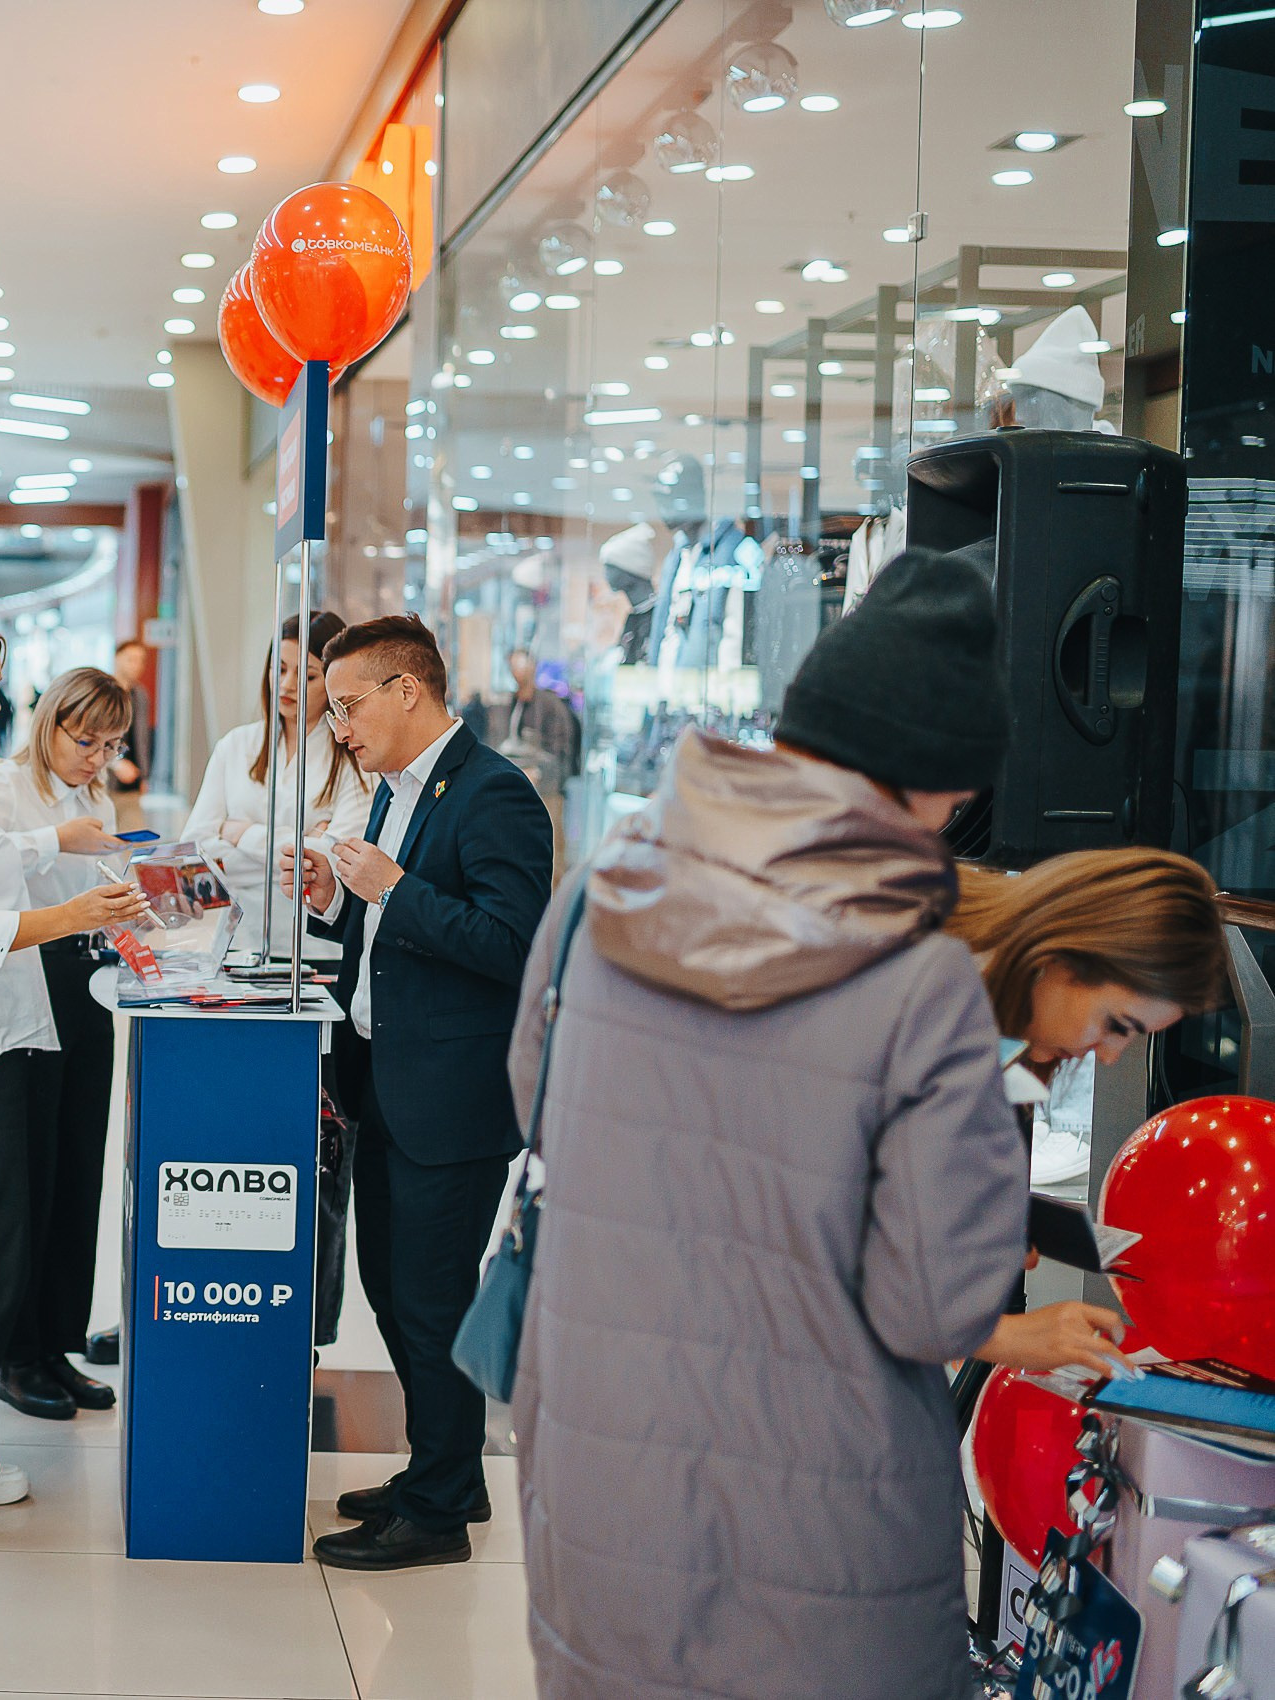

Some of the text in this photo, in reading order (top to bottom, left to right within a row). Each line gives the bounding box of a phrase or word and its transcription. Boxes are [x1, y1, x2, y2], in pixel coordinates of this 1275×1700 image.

[307, 238, 394, 257] СОВКОМБАНК
[163, 1281, 196, 1304] 10
[203, 1282, 263, 1306] 000
[163, 1310, 260, 1324] 3 сертификата
